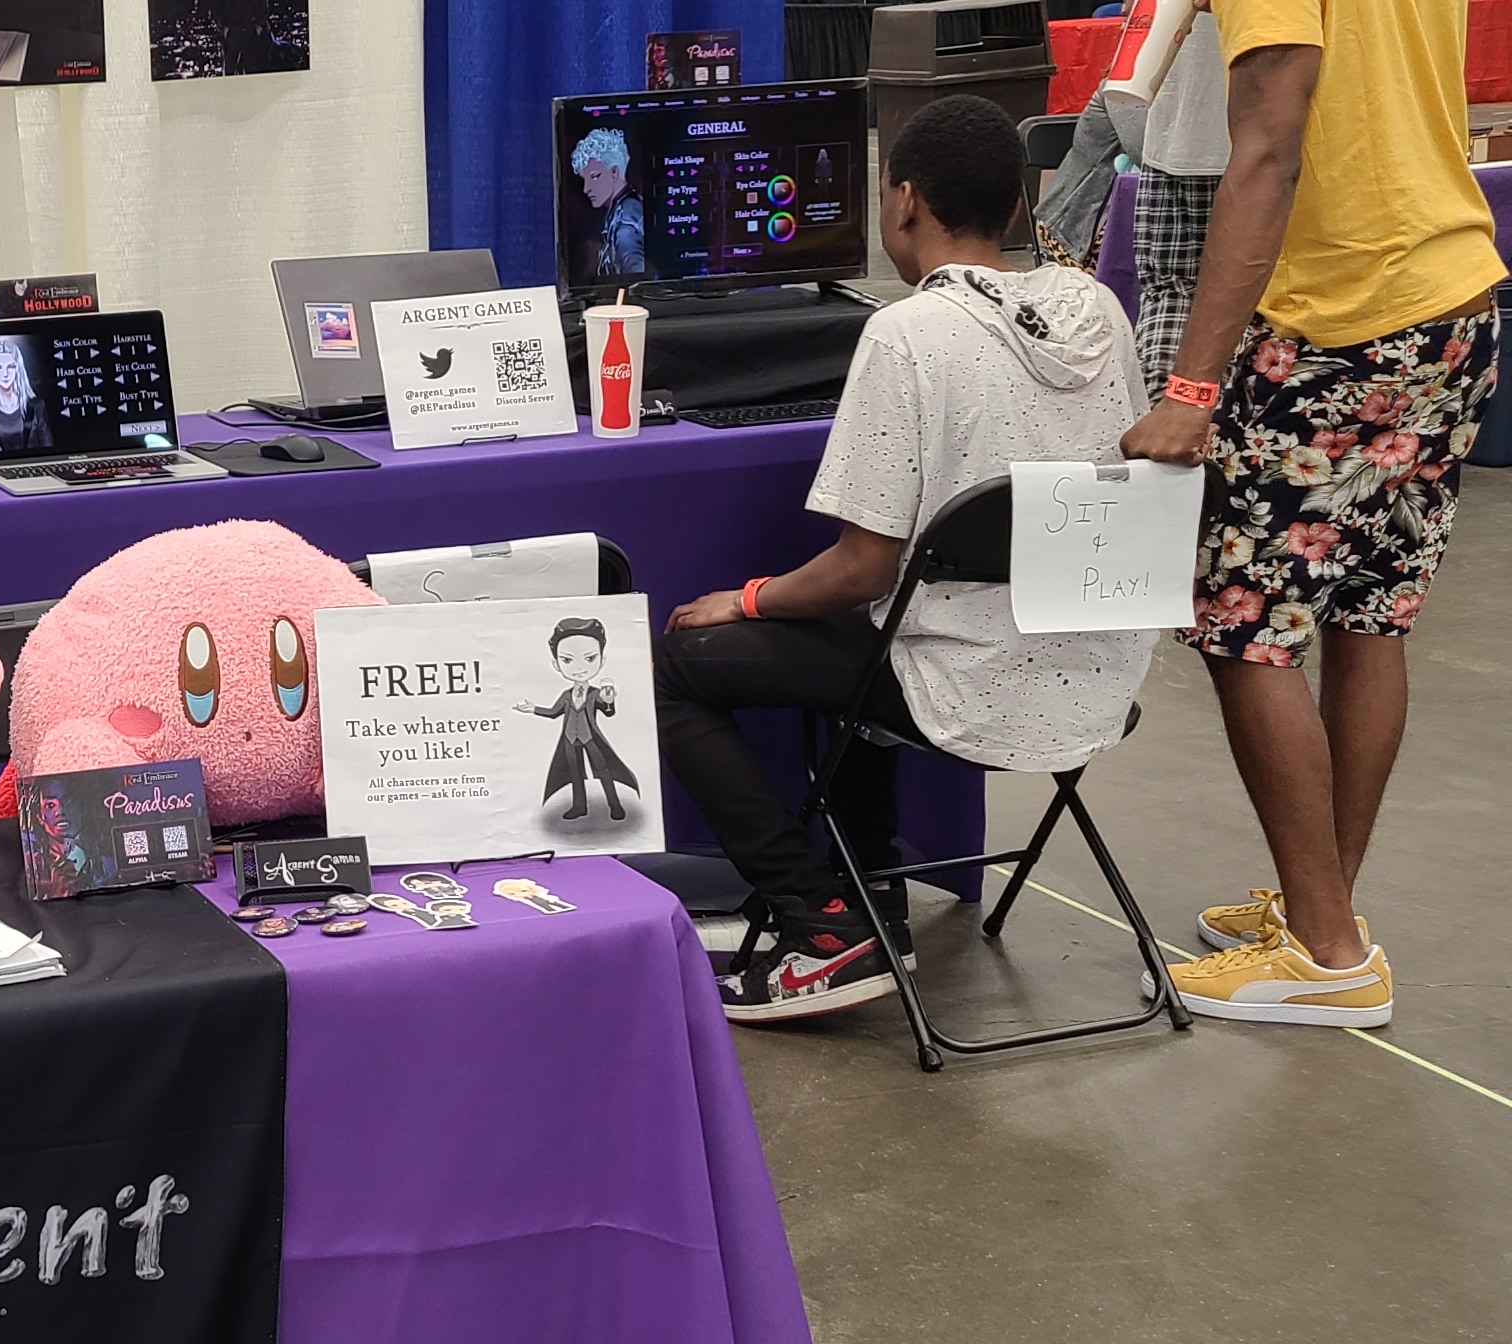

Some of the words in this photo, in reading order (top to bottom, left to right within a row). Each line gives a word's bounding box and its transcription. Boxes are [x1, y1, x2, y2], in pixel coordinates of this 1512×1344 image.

[688, 121, 746, 135] GENERAL
[664, 157, 683, 165] Facial
[684, 155, 705, 166] Shape
[750, 151, 769, 160] Color
[681, 185, 698, 195] Type
[736, 181, 749, 191] Eye
[749, 180, 768, 189] Color
[668, 213, 699, 225] Hairstyle
[735, 209, 750, 218] Hair
[751, 209, 770, 218] Color
[24, 295, 92, 312] HOLLYWOOD
[402, 306, 470, 324] ARGENT
[474, 300, 532, 317] GAMES
[74, 349, 79, 360] 1
[131, 345, 136, 355] 1
[78, 378, 83, 388] 1
[135, 373, 139, 384] 1
[405, 386, 477, 400] @argent_games
[496, 395, 526, 405] Discord
[528, 394, 555, 403] Server
[81, 406, 86, 416] 1
[138, 402, 143, 412] 1
[410, 401, 476, 415] @REParadisus
[359, 661, 482, 698] FREE!
[345, 719, 397, 738] Take
[403, 716, 500, 735] whatever
[379, 748, 418, 767] you
[424, 740, 471, 760] like!
[123, 774, 143, 787] Red
[143, 771, 179, 785] Embrace
[369, 777, 385, 788] All
[387, 777, 439, 788] characters
[442, 777, 459, 785] are
[461, 774, 486, 784] from
[367, 794, 385, 802] our
[387, 793, 419, 803] games
[431, 789, 449, 799] ask
[451, 788, 467, 798] for
[469, 787, 490, 797] info
[103, 787, 195, 819] Paradisus
[263, 852, 316, 886] Argent
[316, 854, 362, 884] Games
